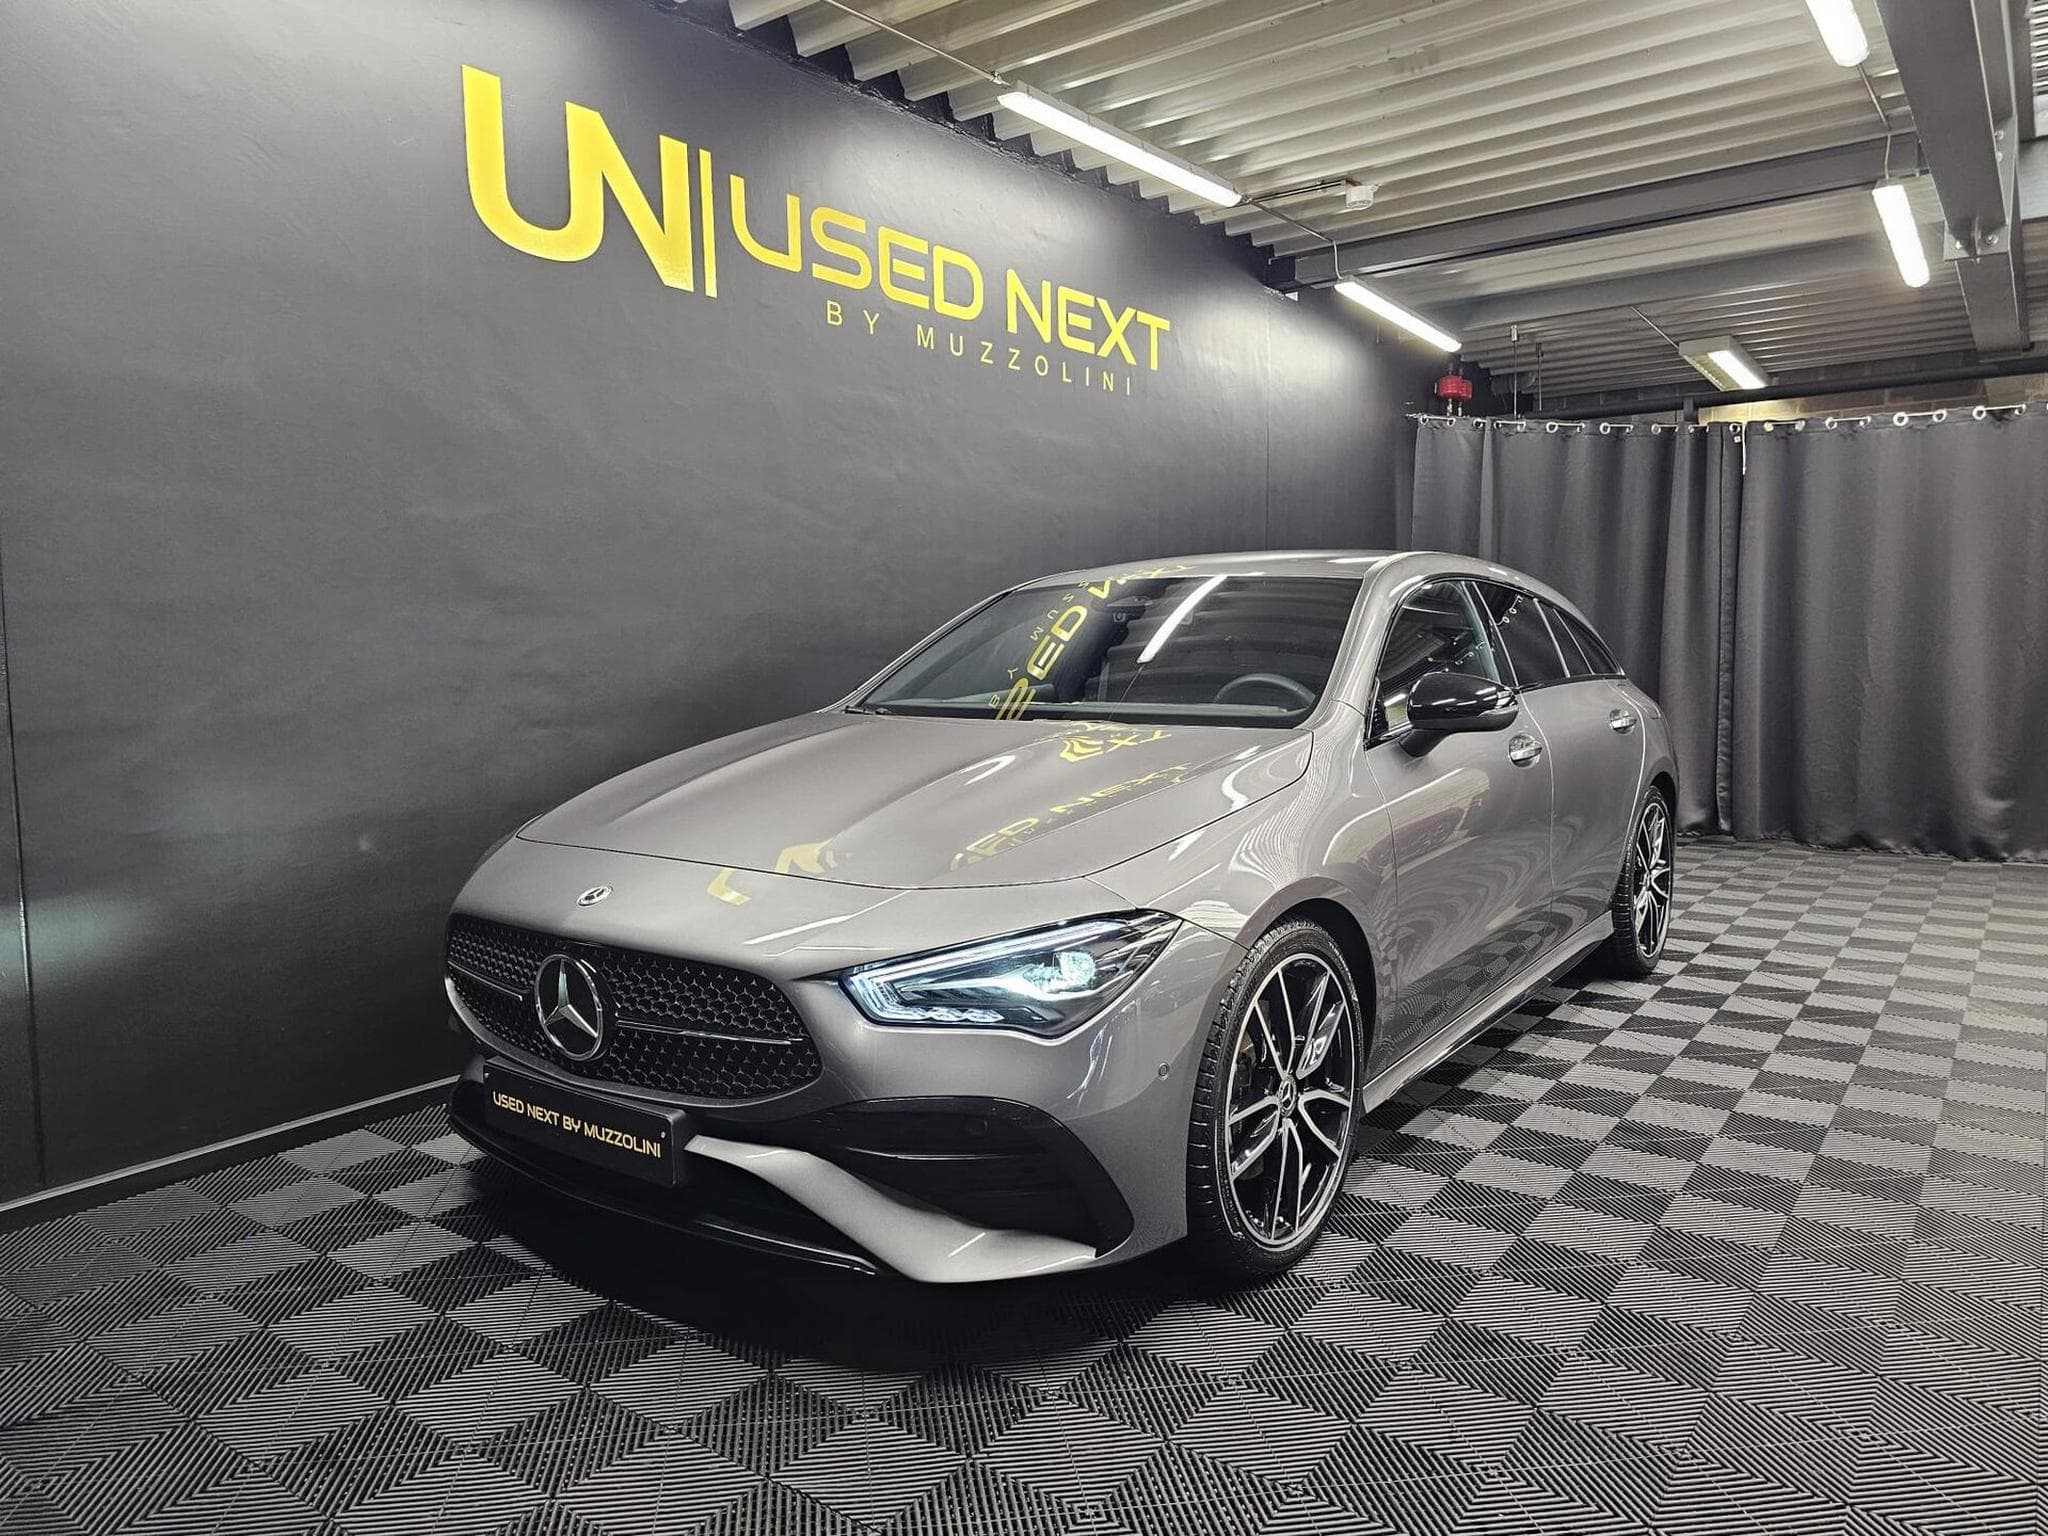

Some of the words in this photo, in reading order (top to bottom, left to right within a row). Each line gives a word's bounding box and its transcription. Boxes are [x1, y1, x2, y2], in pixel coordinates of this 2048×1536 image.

[729, 173, 984, 321] USED
[1005, 269, 1171, 371] NEXT
[826, 300, 880, 335] BY
[916, 324, 1130, 396] MUZZOLINI
[492, 1091, 524, 1113] USED
[527, 1103, 559, 1126] NEXT
[562, 1115, 581, 1132] BY
[584, 1122, 661, 1158] MUZZOLINI
